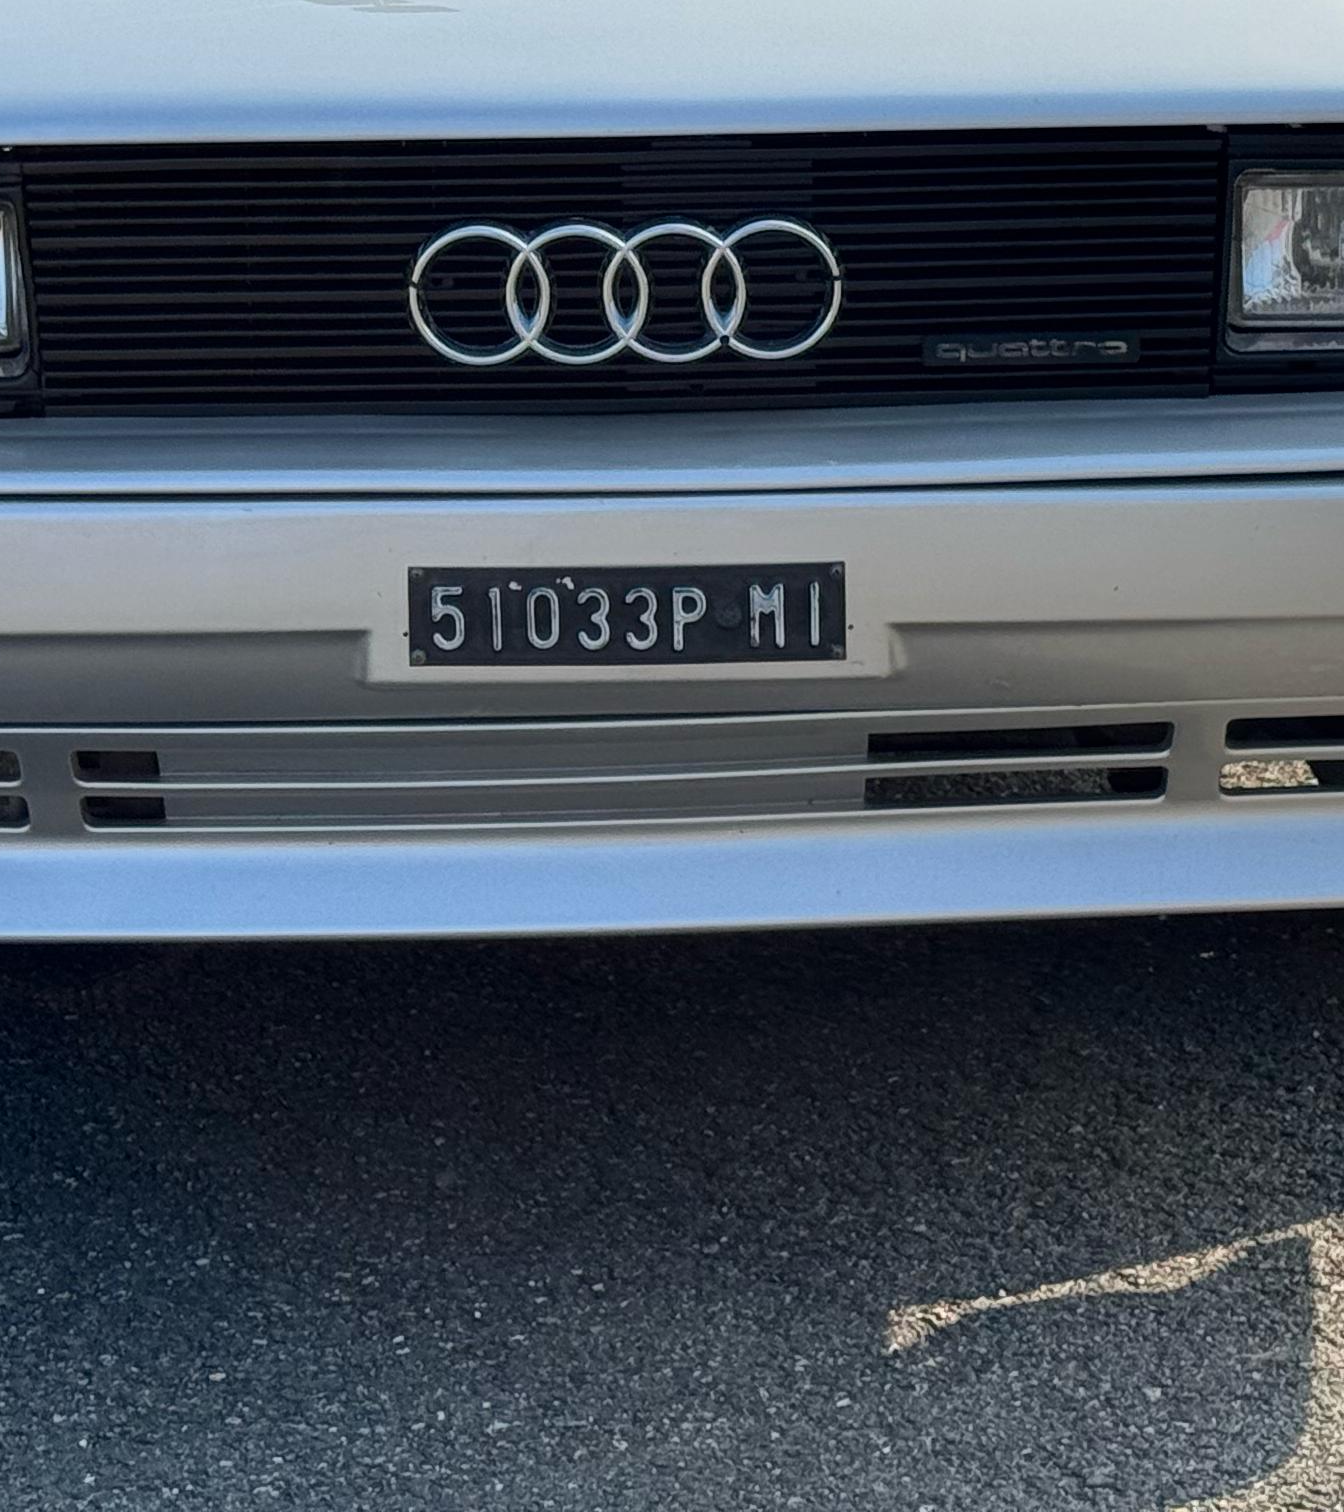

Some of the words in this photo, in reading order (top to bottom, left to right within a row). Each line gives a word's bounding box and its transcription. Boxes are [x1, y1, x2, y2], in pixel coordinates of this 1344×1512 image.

[935, 338, 1128, 362] quattro
[430, 586, 708, 652] 51033P
[749, 582, 825, 649] MI
